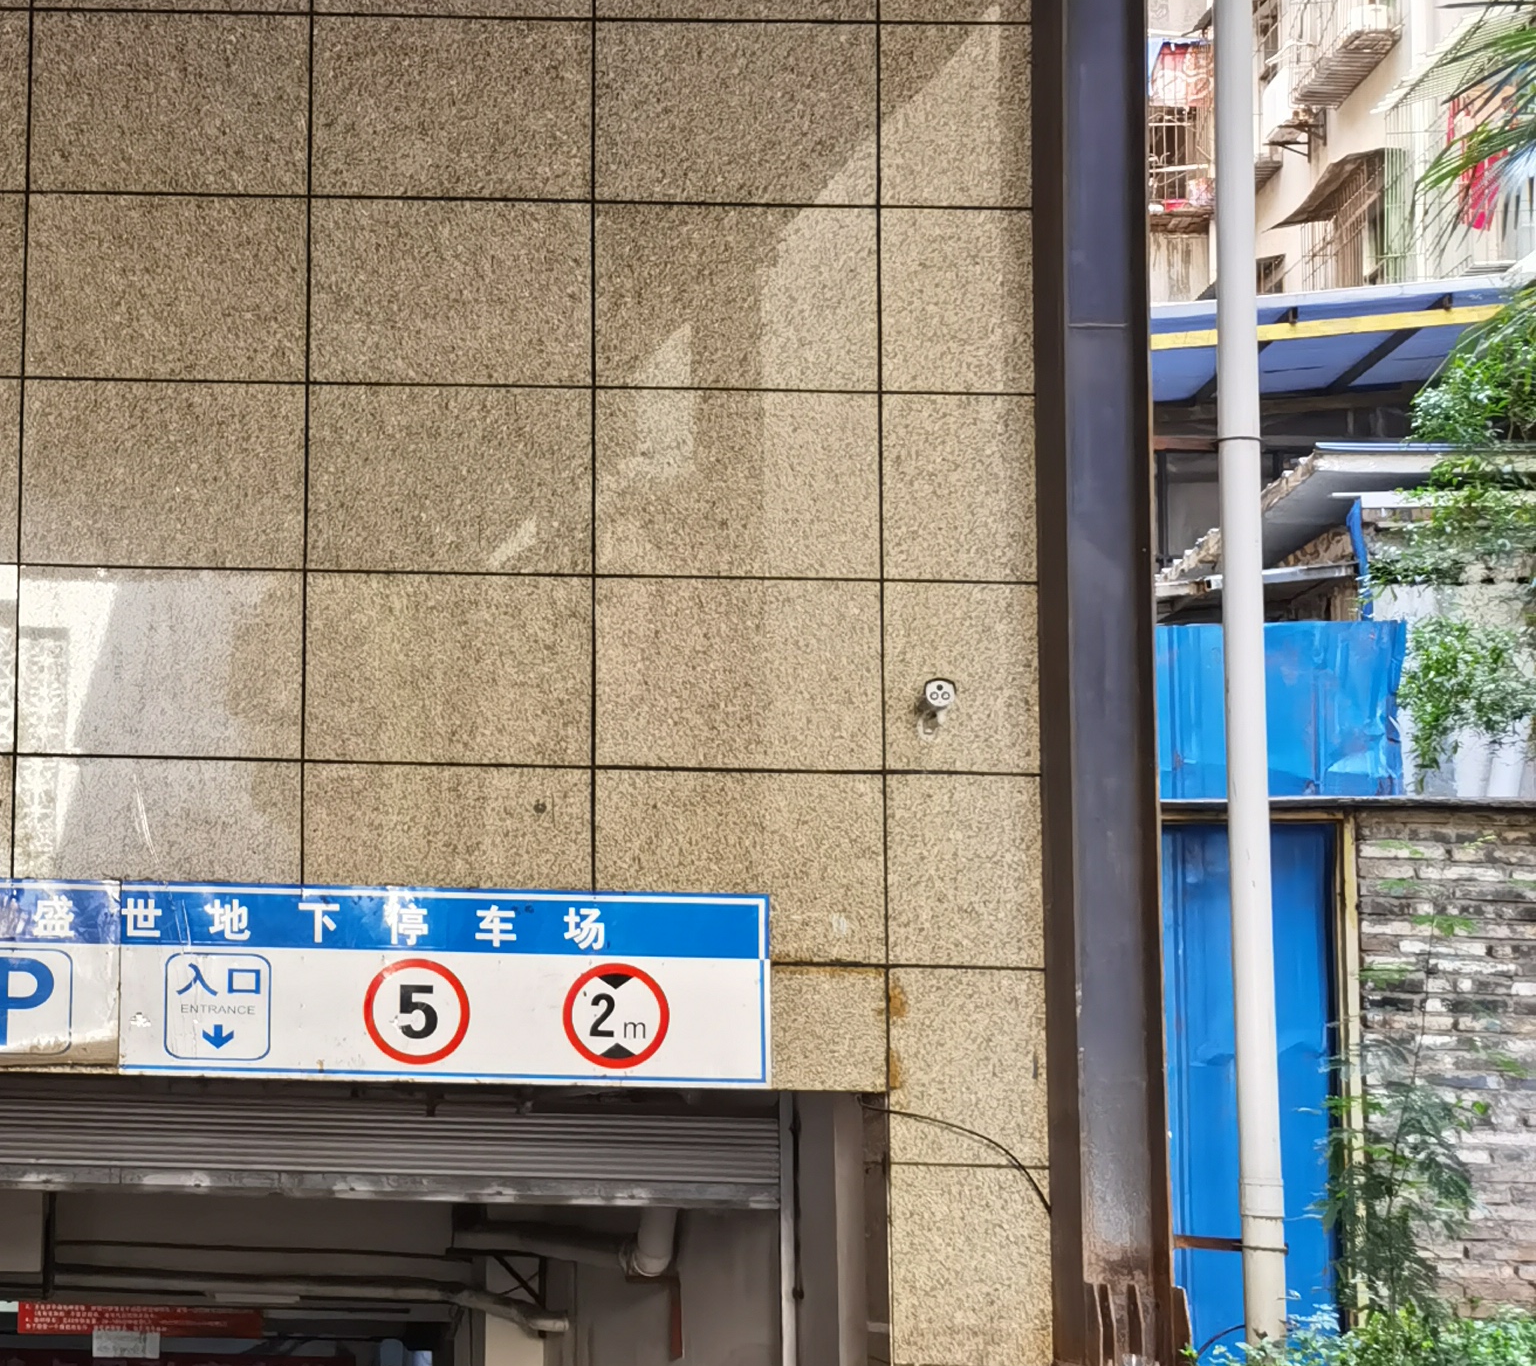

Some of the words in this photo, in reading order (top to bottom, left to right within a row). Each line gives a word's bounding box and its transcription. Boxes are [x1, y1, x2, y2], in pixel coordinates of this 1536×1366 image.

[176, 962, 261, 996] 入口
[180, 1003, 256, 1015] ENTRANCE
[397, 984, 439, 1040] 5
